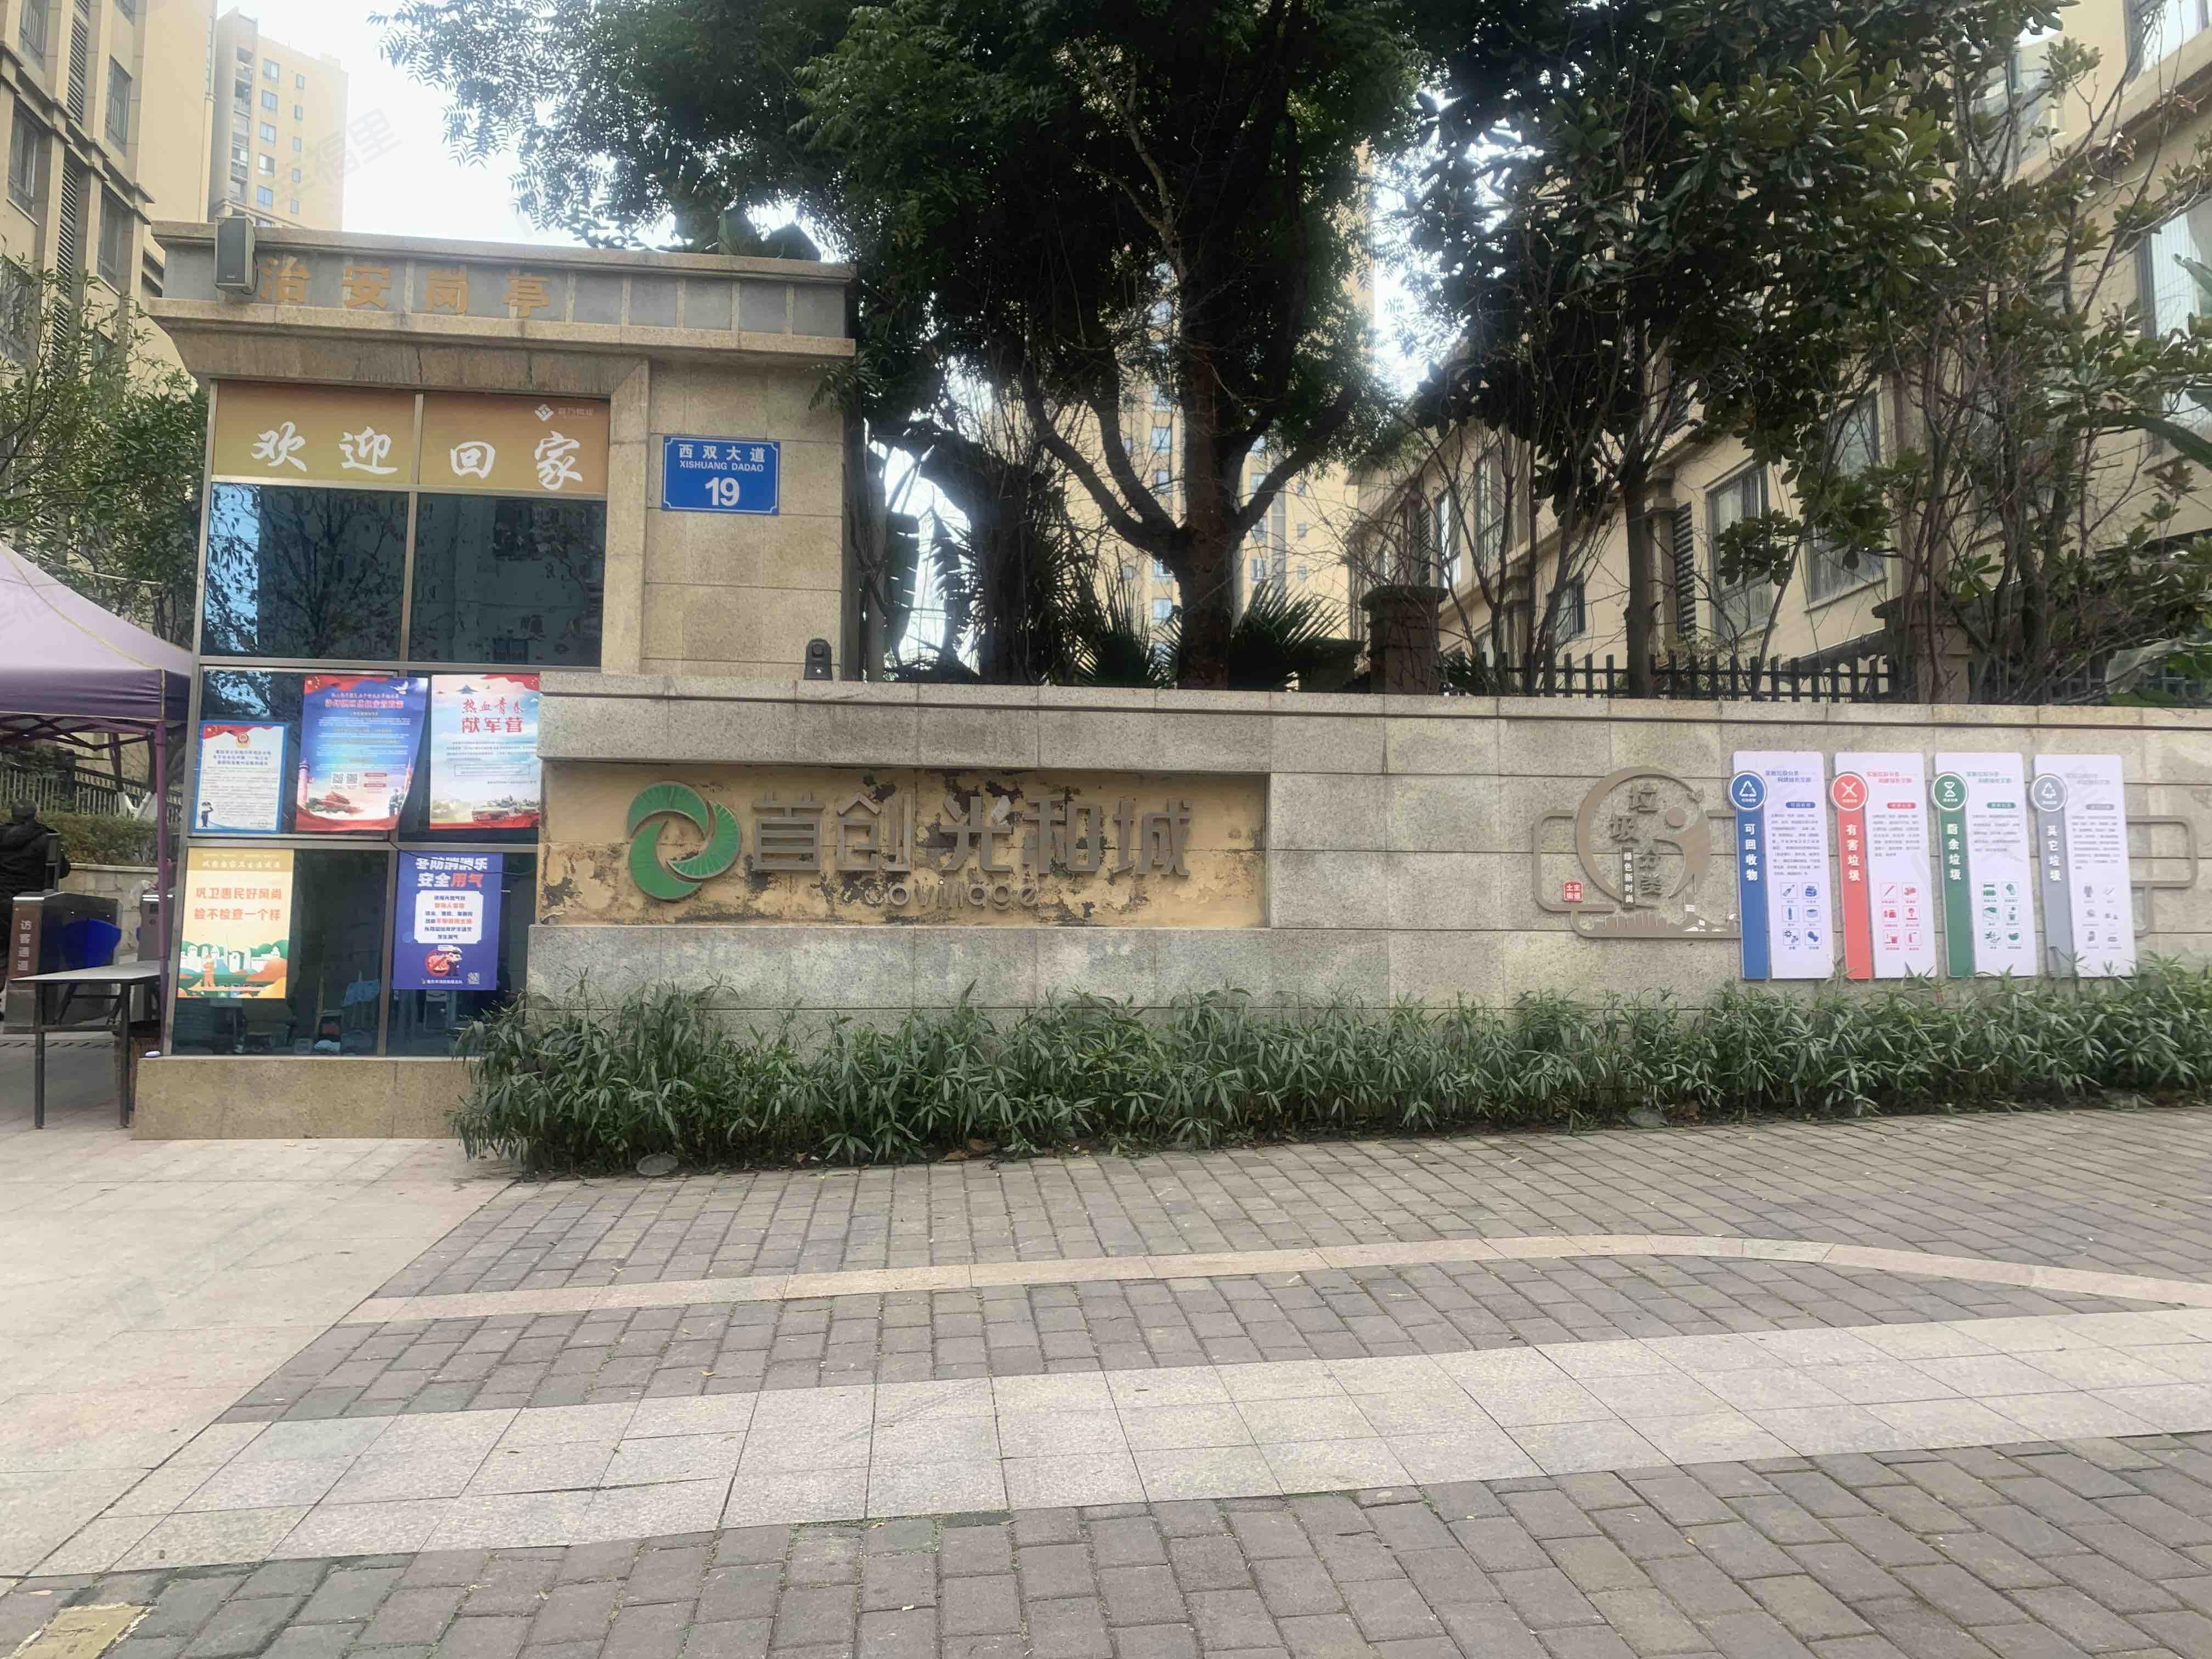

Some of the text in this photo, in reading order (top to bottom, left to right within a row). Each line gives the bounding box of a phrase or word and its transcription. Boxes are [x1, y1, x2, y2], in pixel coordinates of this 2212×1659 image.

[259, 256, 551, 318] 治安岗亭
[251, 421, 583, 490] 欢迎回家
[678, 444, 765, 462] 西双大道
[680, 460, 764, 472] XISHUANG DADAO
[705, 477, 740, 506] 19
[462, 717, 523, 733] 献军营
[751, 792, 1192, 877] 首创光和城
[1744, 823, 1758, 881] 可回收物
[1846, 824, 1861, 882] 有害垃圾
[1946, 823, 1962, 881] 厨余垃圾
[2046, 825, 2062, 882] 其它垃圾
[195, 887, 281, 900] 巩卫惠民好风尚
[417, 873, 483, 887] 安全用气
